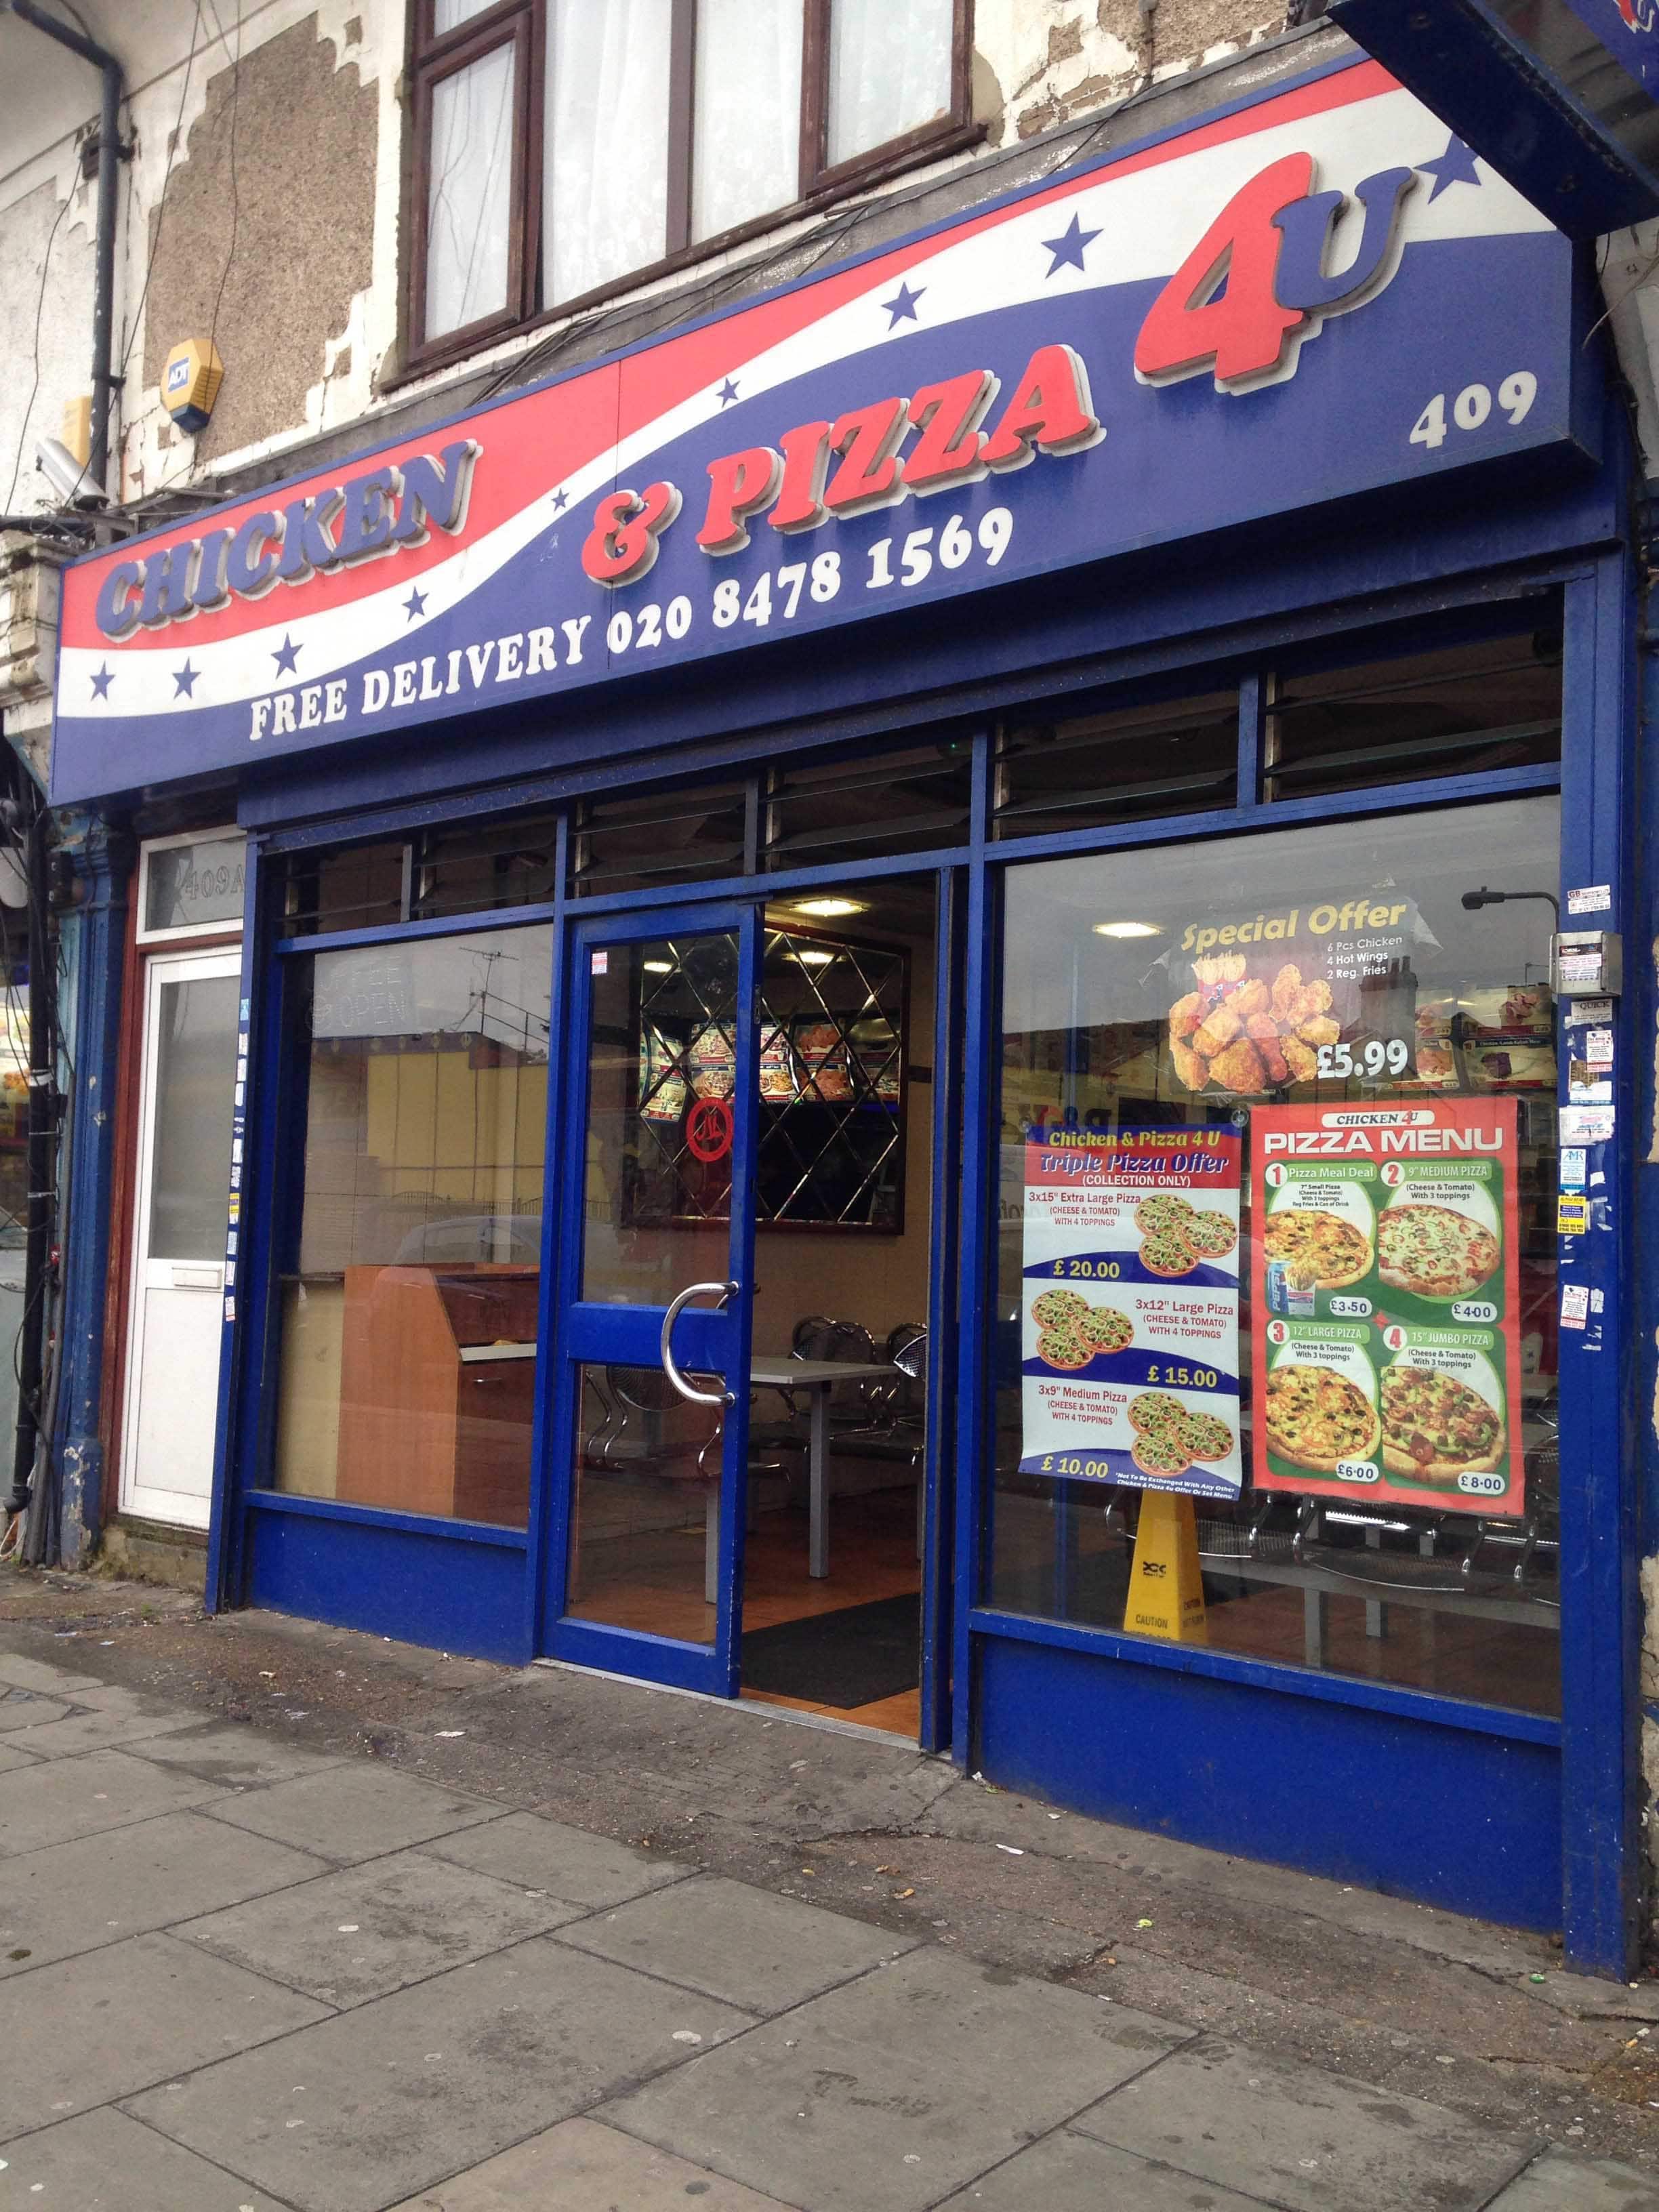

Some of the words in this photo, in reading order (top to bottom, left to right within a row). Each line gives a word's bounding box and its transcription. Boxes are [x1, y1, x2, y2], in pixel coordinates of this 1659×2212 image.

[168, 363, 190, 386] ADT
[1409, 371, 1538, 449] 409
[96, 438, 483, 644] CHICKEN
[581, 480, 682, 588] &
[695, 344, 1107, 557] PIZZA
[249, 678, 348, 742] FREE
[361, 615, 592, 715] DELIVERY
[606, 596, 692, 654] 020
[712, 551, 841, 628] 8478
[866, 508, 1014, 589] 1569
[1181, 909, 1299, 954] Special
[1308, 900, 1407, 935] Offer
[1327, 943, 1333, 952] 6
[1336, 941, 1354, 952] Pcs
[1357, 935, 1402, 949] Chicken
[1326, 956, 1334, 965] 4
[1336, 954, 1354, 965] Hot
[1357, 951, 1389, 965] Wings
[1327, 970, 1333, 979] 2
[1336, 968, 1360, 980] Reg.
[1363, 966, 1387, 977] Fries
[1317, 1038, 1409, 1080] £5.99
[1336, 1113, 1399, 1126] CHICKEN
[1049, 1130, 1118, 1147] Chicken
[1122, 1132, 1135, 1146] &
[1139, 1132, 1187, 1147] Pizza
[1191, 1132, 1203, 1146] 4
[1206, 1132, 1221, 1146] U
[1264, 1130, 1374, 1154] PIZZA
[1380, 1127, 1503, 1153] MENU
[1041, 1153, 1103, 1176] Triple
[1107, 1153, 1166, 1172] Pizza
[1171, 1153, 1229, 1173] Offer
[1420, 1166, 1459, 1177] MEDIUM
[1461, 1165, 1488, 1176] PIZZA
[1272, 1166, 1282, 1186] 1
[1289, 1168, 1317, 1179] Pizza
[1319, 1167, 1347, 1178] Meal
[1349, 1166, 1374, 1177] Deal
[1387, 1164, 1399, 1185] 2
[1082, 1175, 1155, 1187] (COLLECTION
[1158, 1175, 1191, 1187] ONLY)
[1406, 1183, 1435, 1192] (Cheese
[1444, 1183, 1475, 1192] Tomato)
[1029, 1191, 1059, 1203] 3x15"
[1061, 1193, 1084, 1203] Extra
[1087, 1193, 1113, 1205] Large
[1116, 1193, 1141, 1204] Pizza
[1436, 1192, 1471, 1201] toppings
[1050, 1206, 1080, 1216] (CHEESE
[1088, 1207, 1120, 1216] TOMATO)
[1054, 1217, 1073, 1225] WITH
[1073, 1217, 1078, 1225] 4
[1080, 1218, 1115, 1227] TOPPINGS
[1069, 1261, 1120, 1278] 20.00
[1273, 1273, 1281, 1312] PEPSI
[1135, 1298, 1170, 1311] 3x12"
[1172, 1300, 1204, 1315] Large
[1207, 1303, 1233, 1315] Pizza
[1143, 1314, 1180, 1325] (CHEESE
[1182, 1316, 1188, 1325] &
[1190, 1317, 1227, 1329] TOMATO)
[1149, 1326, 1171, 1336] WITH
[1172, 1328, 1179, 1336] 4
[1180, 1328, 1222, 1340] TOPPINGS
[1273, 1323, 1284, 1342] 3
[1308, 1326, 1335, 1338] LARGE
[1336, 1328, 1361, 1338] PIZZA
[1389, 1328, 1401, 1348] 4
[1427, 1332, 1460, 1345] JUMBO
[1462, 1334, 1489, 1346] PIZZA
[1291, 1343, 1317, 1352] (Cheese
[1326, 1344, 1355, 1353] Tomato)
[1408, 1349, 1437, 1358] (Cheese
[1445, 1351, 1476, 1360] Tomato)
[1296, 1351, 1312, 1359] With
[1319, 1352, 1350, 1361] toppings
[1413, 1357, 1430, 1366] With
[1437, 1359, 1471, 1369] toppings
[1165, 1367, 1218, 1388] 15.00
[1038, 1385, 1061, 1396] 3x9"
[1063, 1387, 1101, 1401] Medium
[1103, 1390, 1128, 1403] Pizza
[1048, 1399, 1078, 1411] (CHEESE
[1080, 1403, 1085, 1411] &
[1086, 1403, 1118, 1415] TOMATO)
[1052, 1412, 1071, 1421] WITH
[1071, 1413, 1077, 1421] 4
[1078, 1414, 1113, 1425] TOPPINGS
[1057, 1458, 1109, 1478] 10.00
[1117, 1479, 1141, 1488] Chicken
[1148, 1483, 1164, 1491] Pizza
[1174, 1486, 1192, 1494] Offer
[1213, 1492, 1233, 1500] Menu
[1184, 1481, 1200, 1489] With
[1201, 1483, 1214, 1492] Any
[1215, 1485, 1235, 1493] Other
[1135, 1614, 1168, 1629] CAUTION
